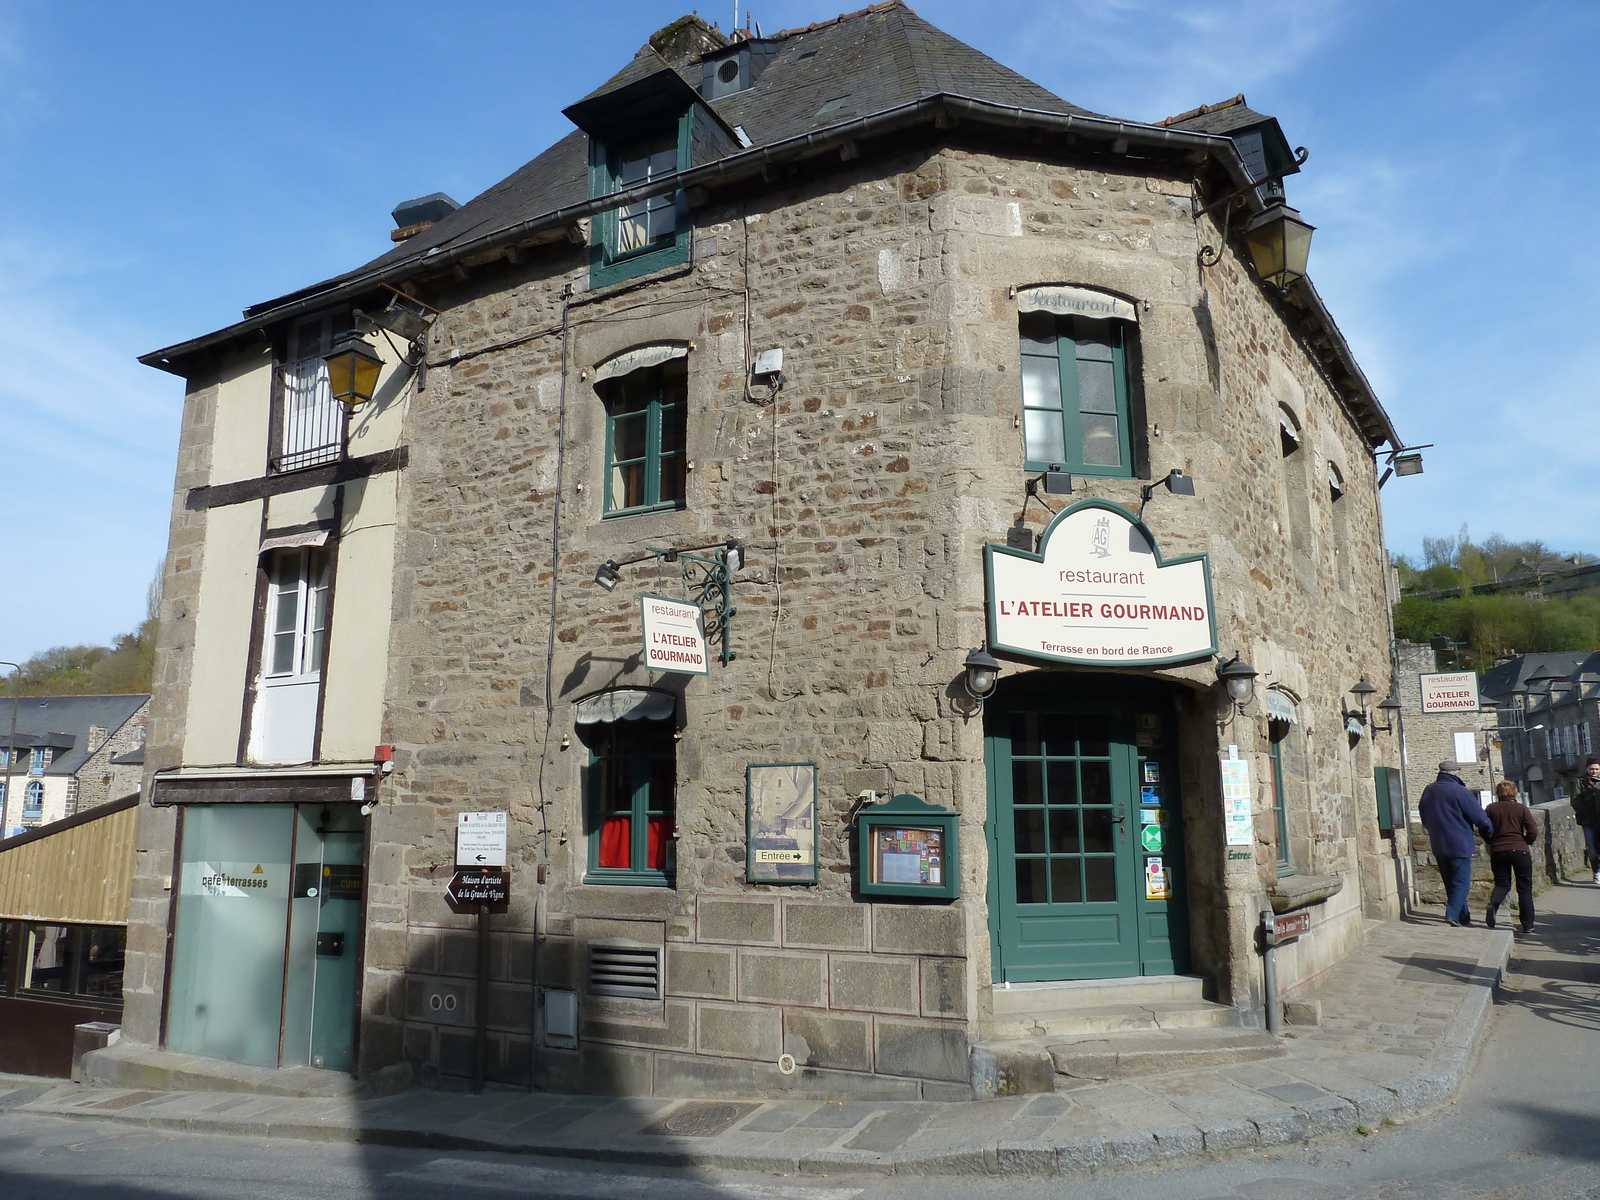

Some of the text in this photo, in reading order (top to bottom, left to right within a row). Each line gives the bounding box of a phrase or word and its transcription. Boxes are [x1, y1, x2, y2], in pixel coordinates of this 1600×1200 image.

[1029, 289, 1119, 314] Restaurant
[1059, 568, 1146, 585] restaurant
[651, 604, 695, 620] restaurant
[1000, 600, 1205, 621] L'ATELIER GOURMAND
[653, 632, 697, 648] L'ATELIER
[1041, 641, 1173, 656] Terrasse en bord de Rance
[650, 648, 703, 665] GOURMAND
[1428, 675, 1469, 683] restaurant
[1429, 691, 1470, 699] L'ATELIER
[1426, 700, 1476, 709] GOURMAND
[761, 851, 791, 860] Entrée
[227, 875, 268, 889] terrasses
[461, 874, 502, 885] Maison d'artiste
[457, 888, 505, 901] de la Grande Vigne
